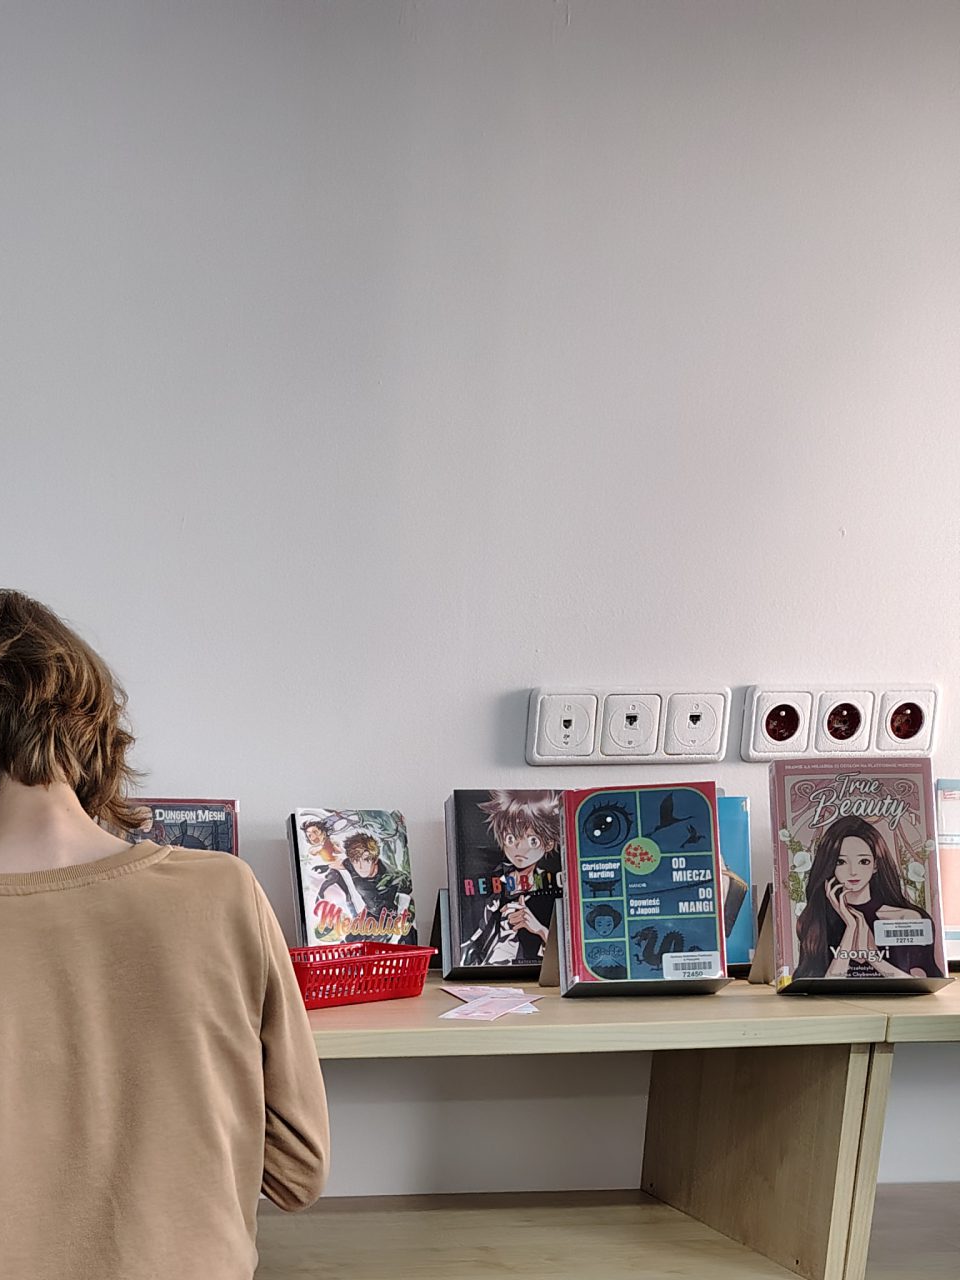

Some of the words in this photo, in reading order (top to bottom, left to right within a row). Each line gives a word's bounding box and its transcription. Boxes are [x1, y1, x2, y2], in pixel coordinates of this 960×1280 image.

[836, 772, 881, 799] True
[155, 809, 196, 821] DUNGEON
[197, 809, 225, 821] MESHI
[809, 787, 909, 830] Beauty
[581, 862, 621, 872] Christopher
[671, 857, 686, 868] OD
[588, 871, 615, 880] Harding
[672, 869, 713, 883] MIECZA
[698, 887, 713, 900] DO
[678, 900, 714, 914] MANGI
[313, 900, 412, 936] Medalist
[830, 946, 890, 961] Yaongyi
